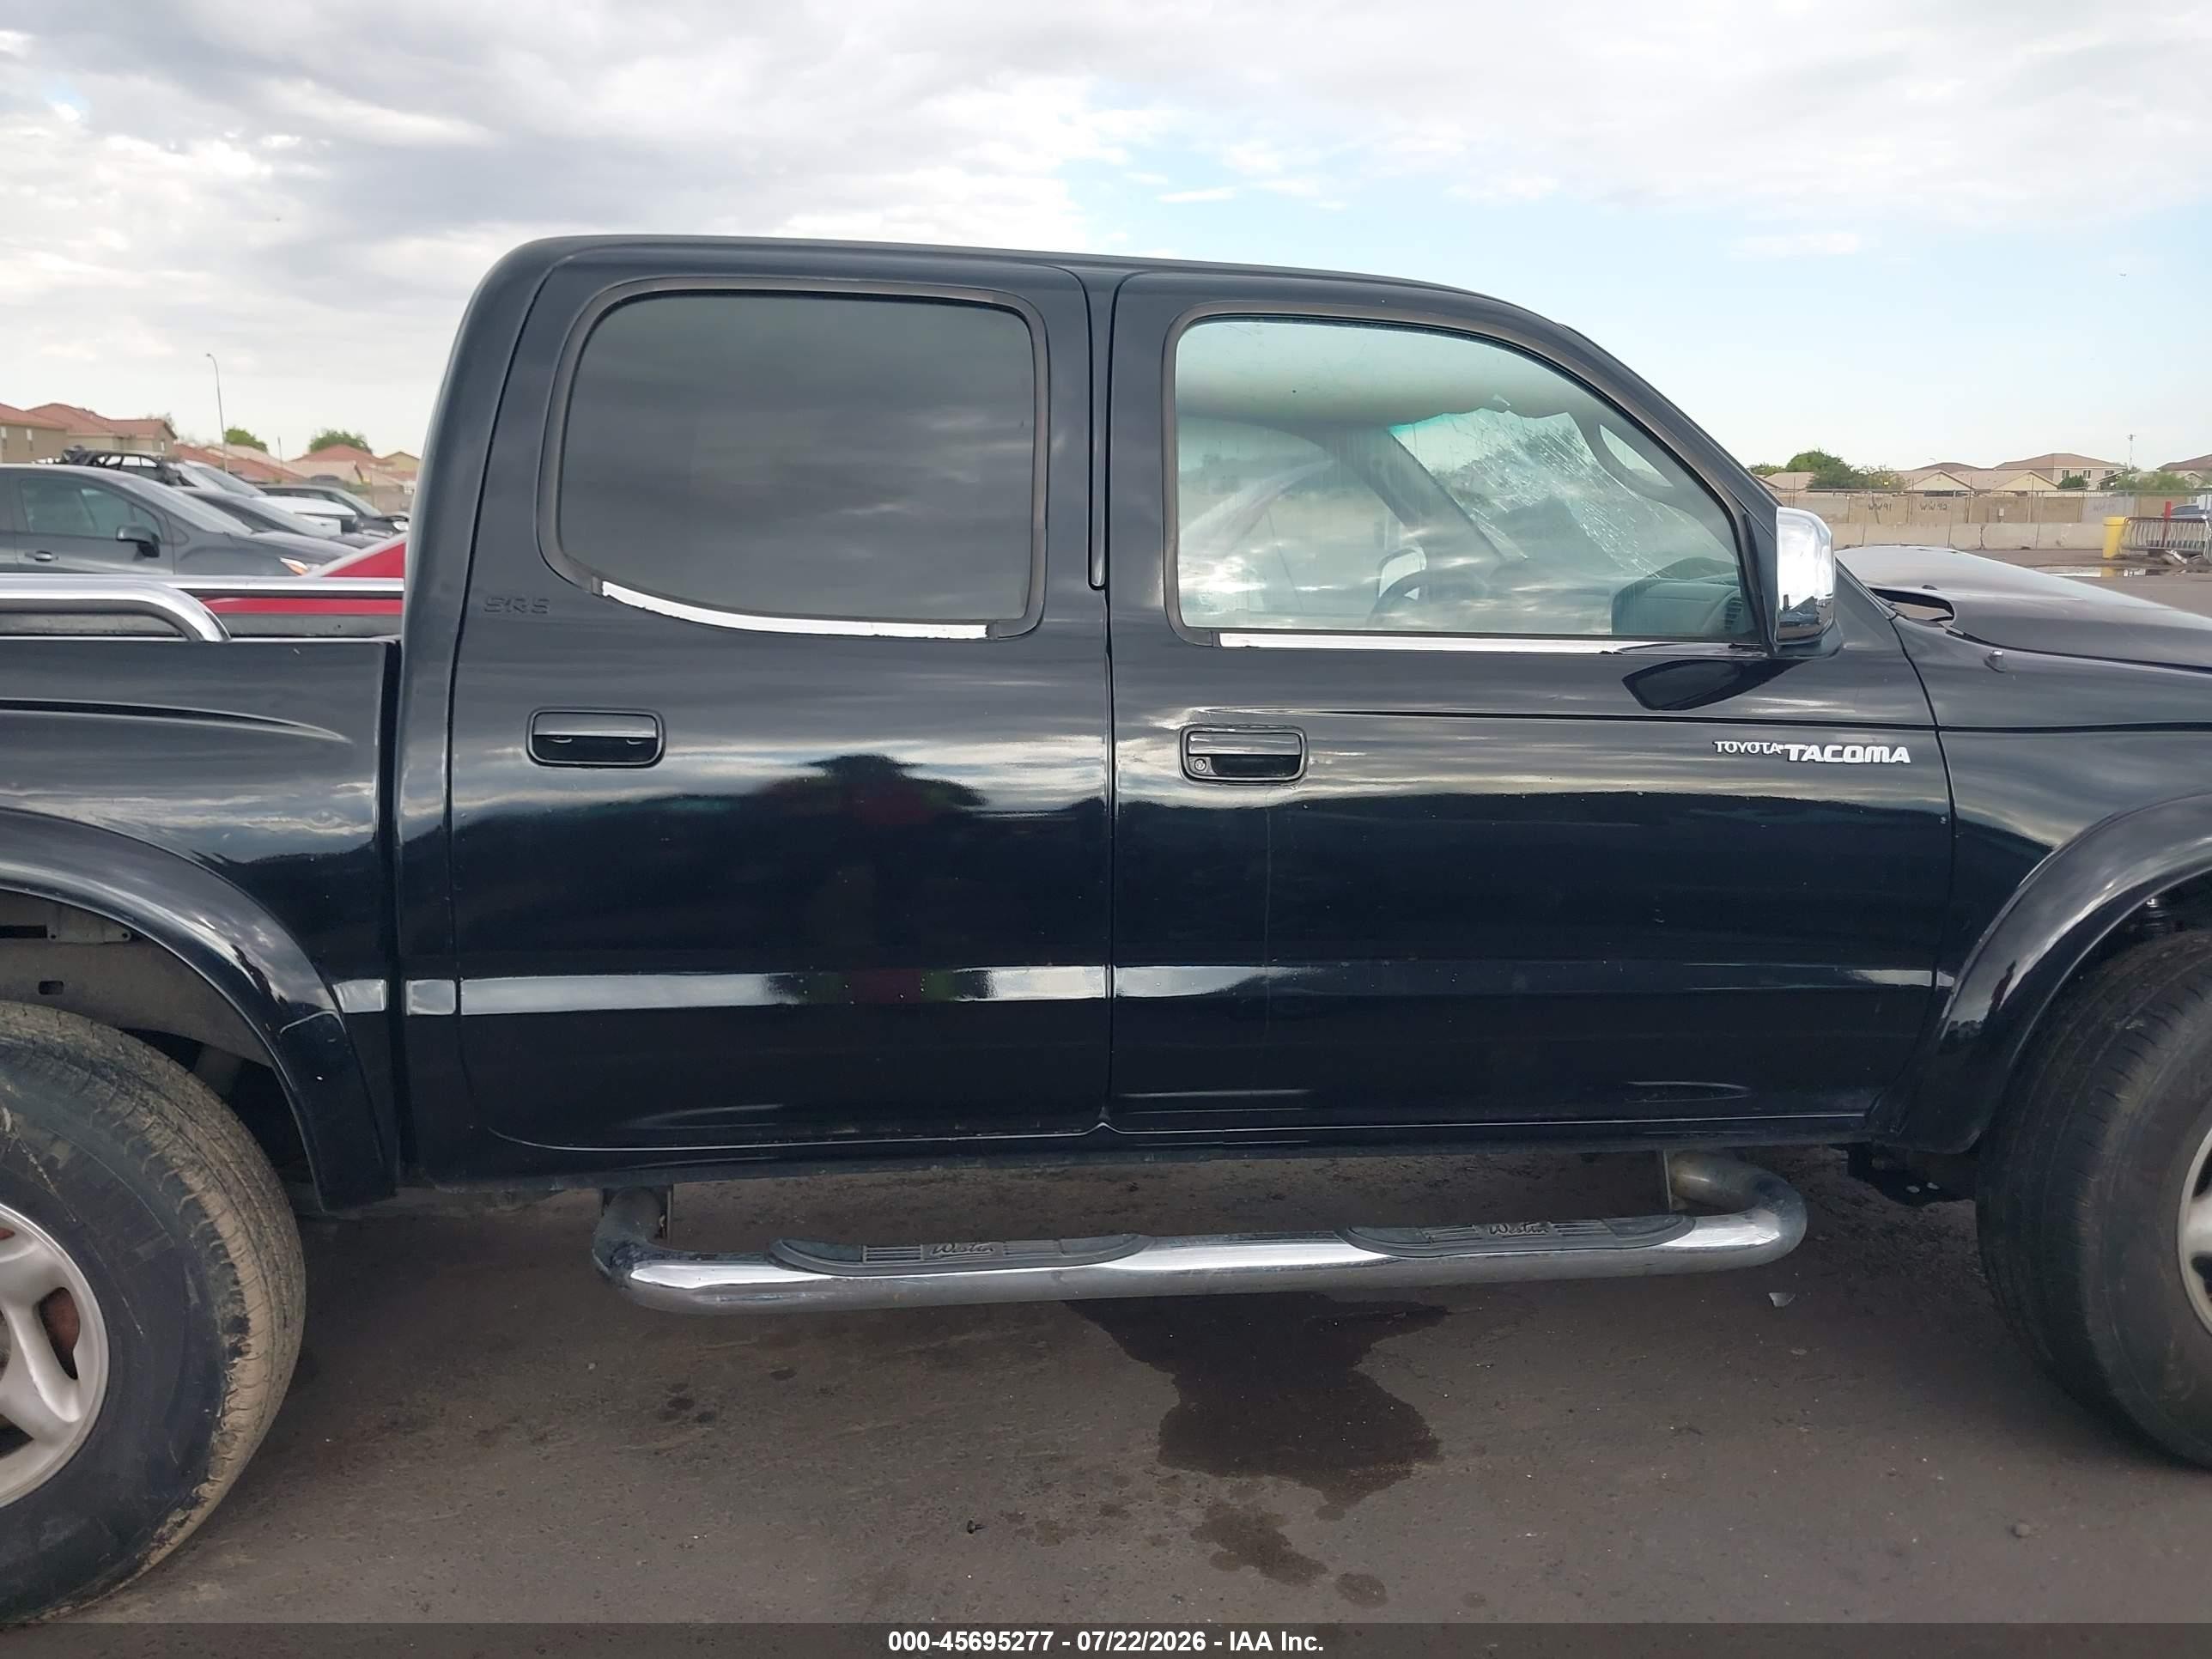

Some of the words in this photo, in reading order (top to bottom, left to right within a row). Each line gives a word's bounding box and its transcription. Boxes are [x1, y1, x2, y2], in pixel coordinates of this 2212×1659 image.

[483, 597, 550, 614] SRS
[1714, 740, 1782, 755] TOYOTA
[1782, 744, 1911, 763] TACOMA
